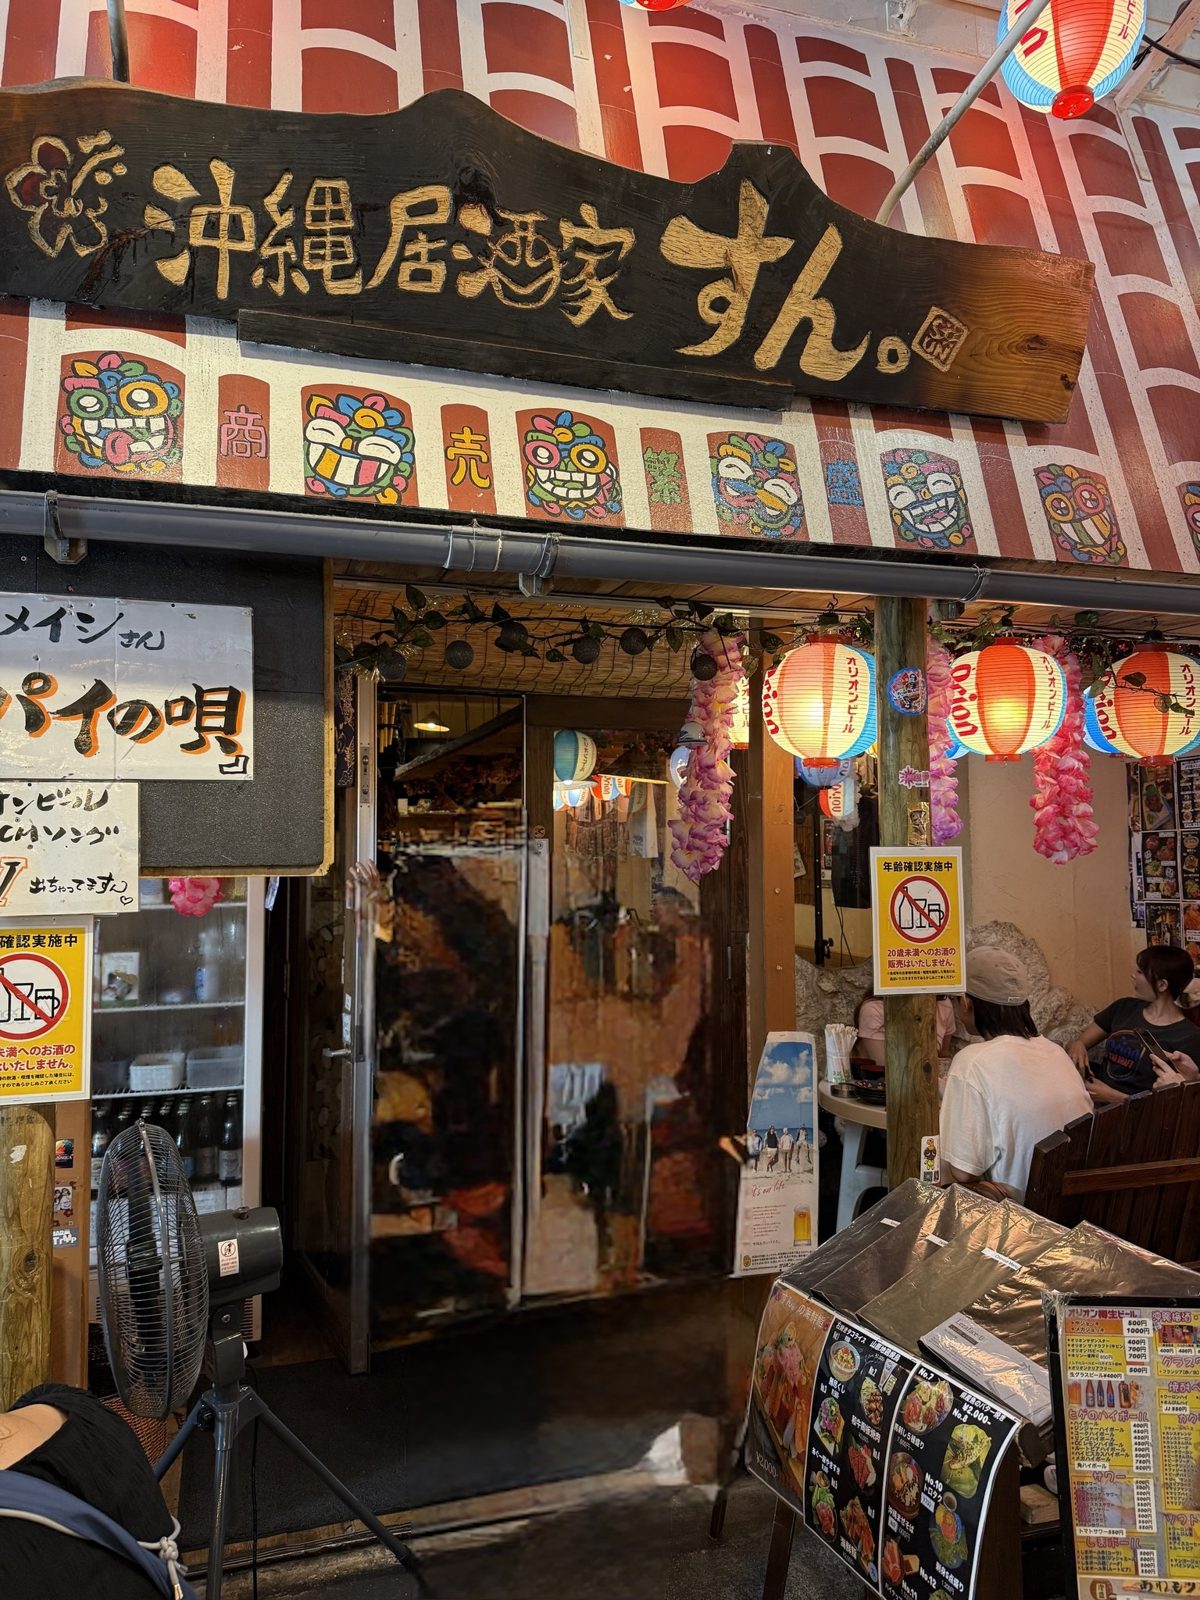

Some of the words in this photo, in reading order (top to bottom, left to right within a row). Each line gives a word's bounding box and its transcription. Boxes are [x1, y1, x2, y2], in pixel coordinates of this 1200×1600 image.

[660, 178, 911, 381] すん。
[219, 405, 268, 460] 商
[445, 425, 492, 490] 売
[843, 656, 860, 734] オリオンビール
[951, 663, 979, 737] Orion
[1039, 655, 1058, 731] オリオンビール
[883, 861, 953, 872] 年齢確認実施中
[887, 947, 956, 957] 20歳未満へのお酒の
[887, 959, 955, 968] 販売はいたしません。
[918, 1367, 935, 1381] No.7
[952, 1407, 969, 1423] No.8
[924, 1472, 943, 1491] No.10
